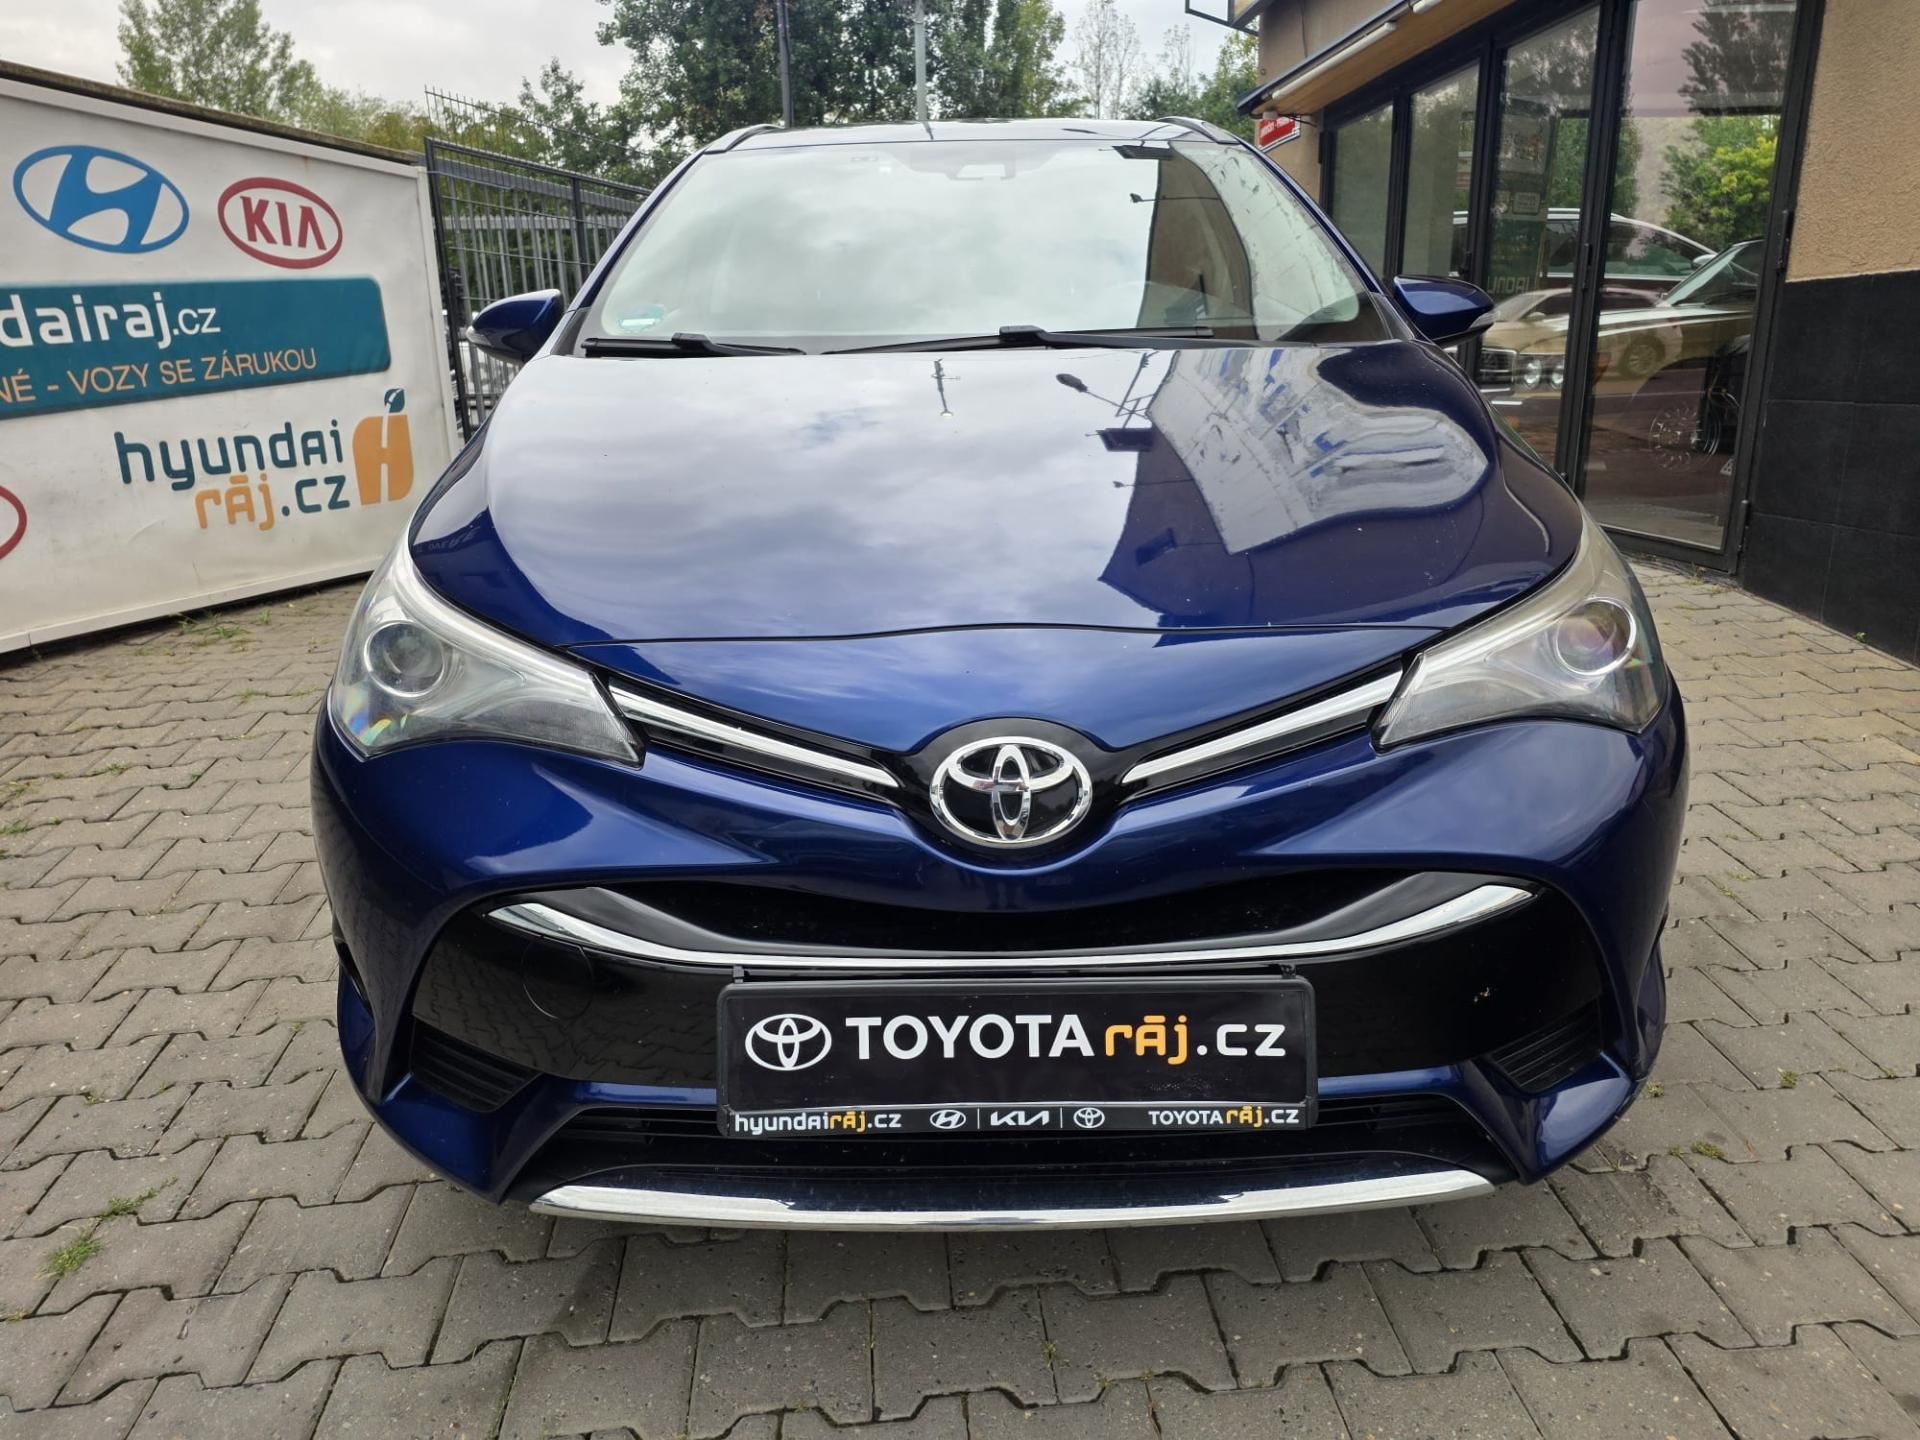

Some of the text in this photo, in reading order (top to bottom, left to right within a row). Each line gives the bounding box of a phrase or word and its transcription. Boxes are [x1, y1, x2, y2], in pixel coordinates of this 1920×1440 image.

[240, 196, 327, 251] KIA
[67, 363, 150, 396] VOZY
[159, 359, 196, 385] SE
[200, 348, 317, 381] ZÁRUKOU
